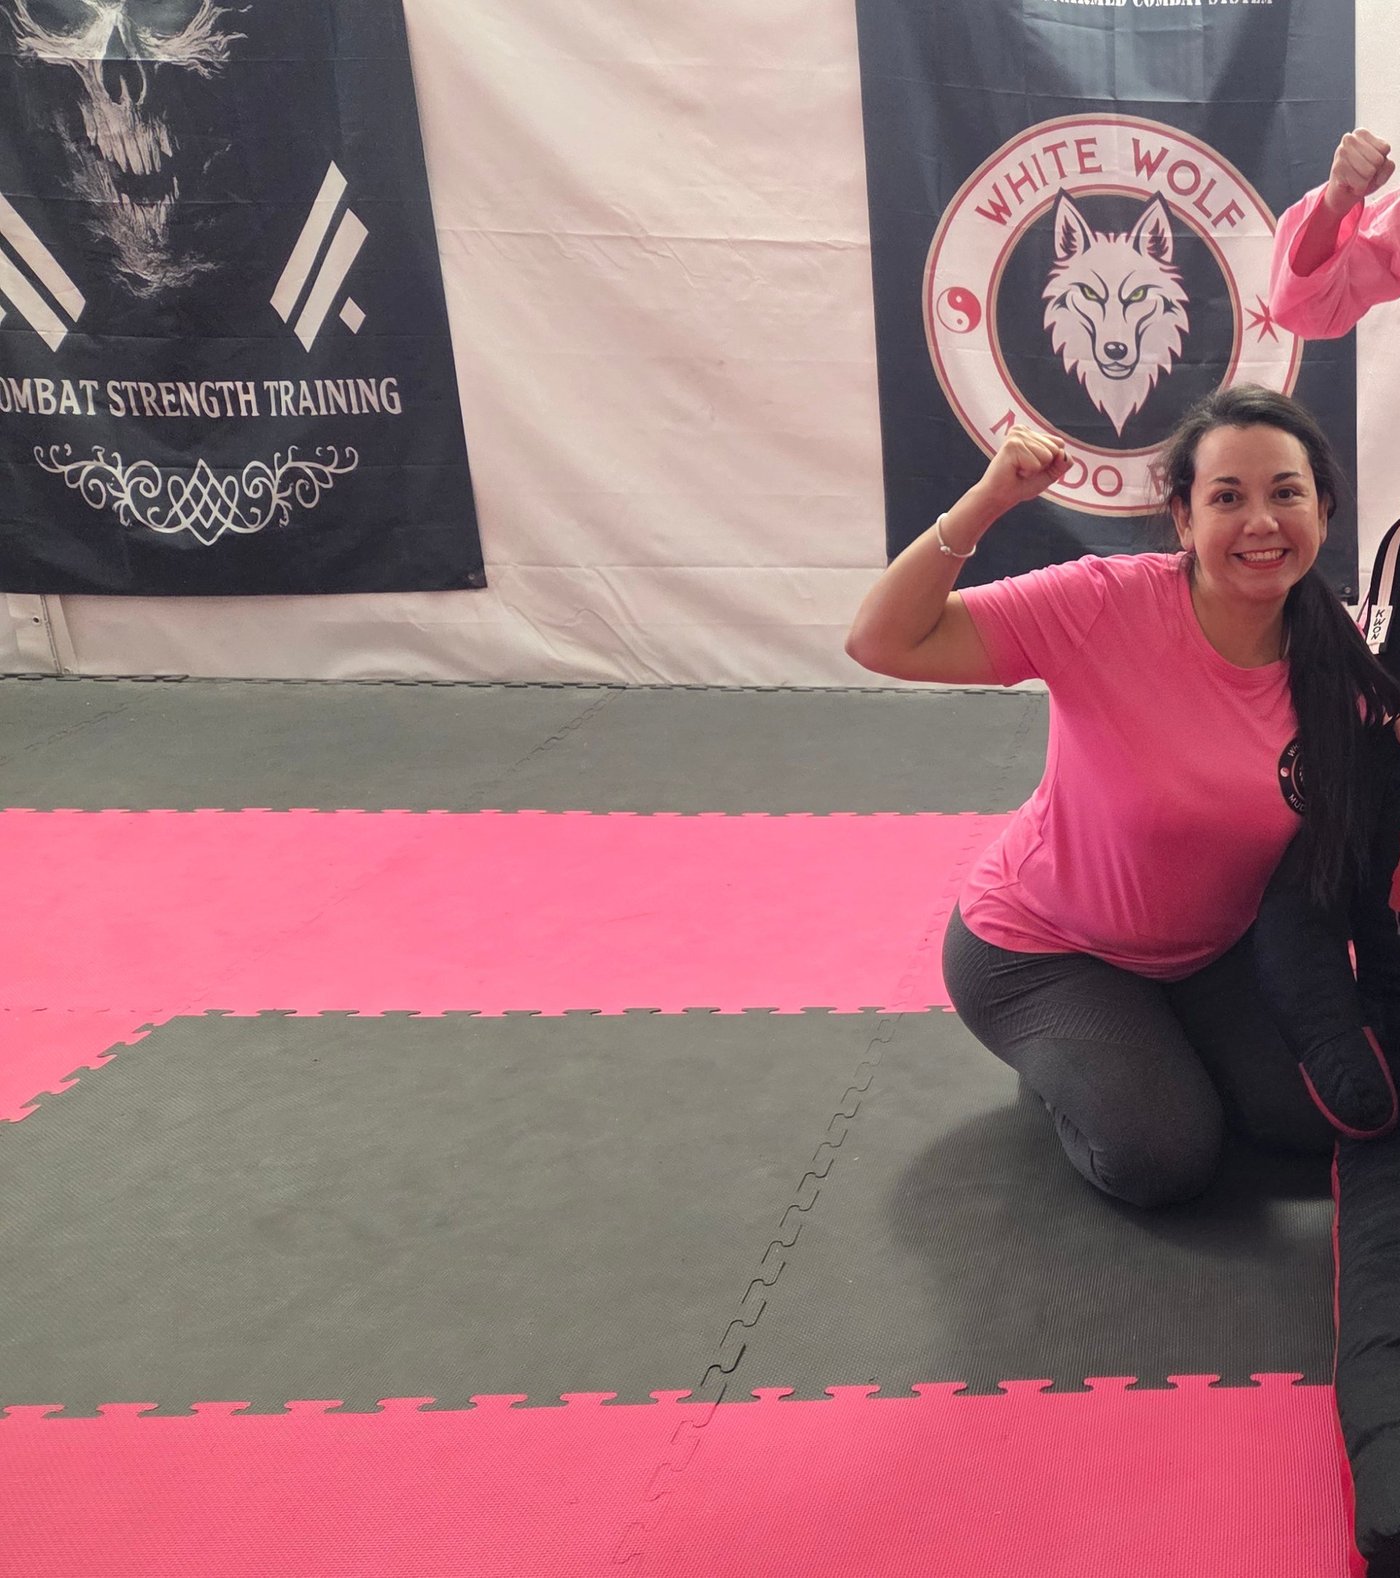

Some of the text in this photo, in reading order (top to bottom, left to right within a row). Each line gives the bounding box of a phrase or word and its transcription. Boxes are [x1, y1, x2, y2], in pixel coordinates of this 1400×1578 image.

[974, 137, 1246, 229] WHITE WOLF
[0, 376, 402, 418] OMBAT STRENGTH TRAINING
[1371, 609, 1386, 640] KWON
